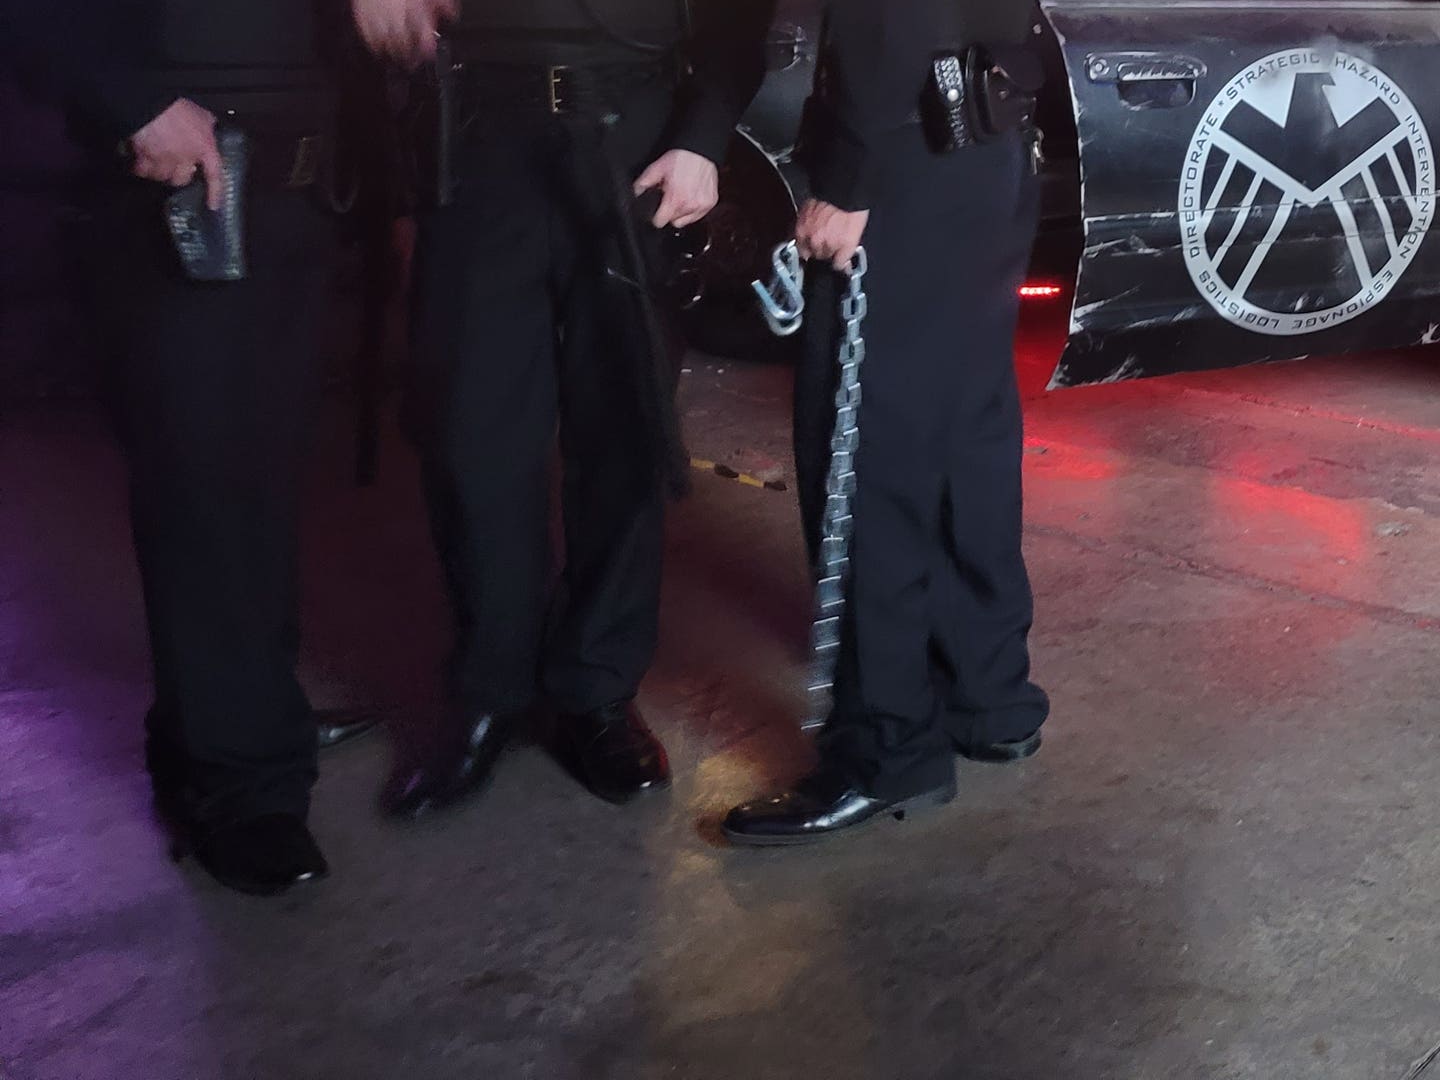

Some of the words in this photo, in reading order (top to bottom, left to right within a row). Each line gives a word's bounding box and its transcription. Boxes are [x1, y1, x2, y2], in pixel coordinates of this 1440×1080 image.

[1183, 116, 1218, 259] DIRECTORATE
[1226, 53, 1320, 100] STRATEGIC
[1335, 56, 1401, 106] HAZARD
[1400, 114, 1431, 259] INTERVENTION
[1198, 270, 1280, 329] LOGISTICS
[1291, 270, 1394, 330] ESPIONAGE
